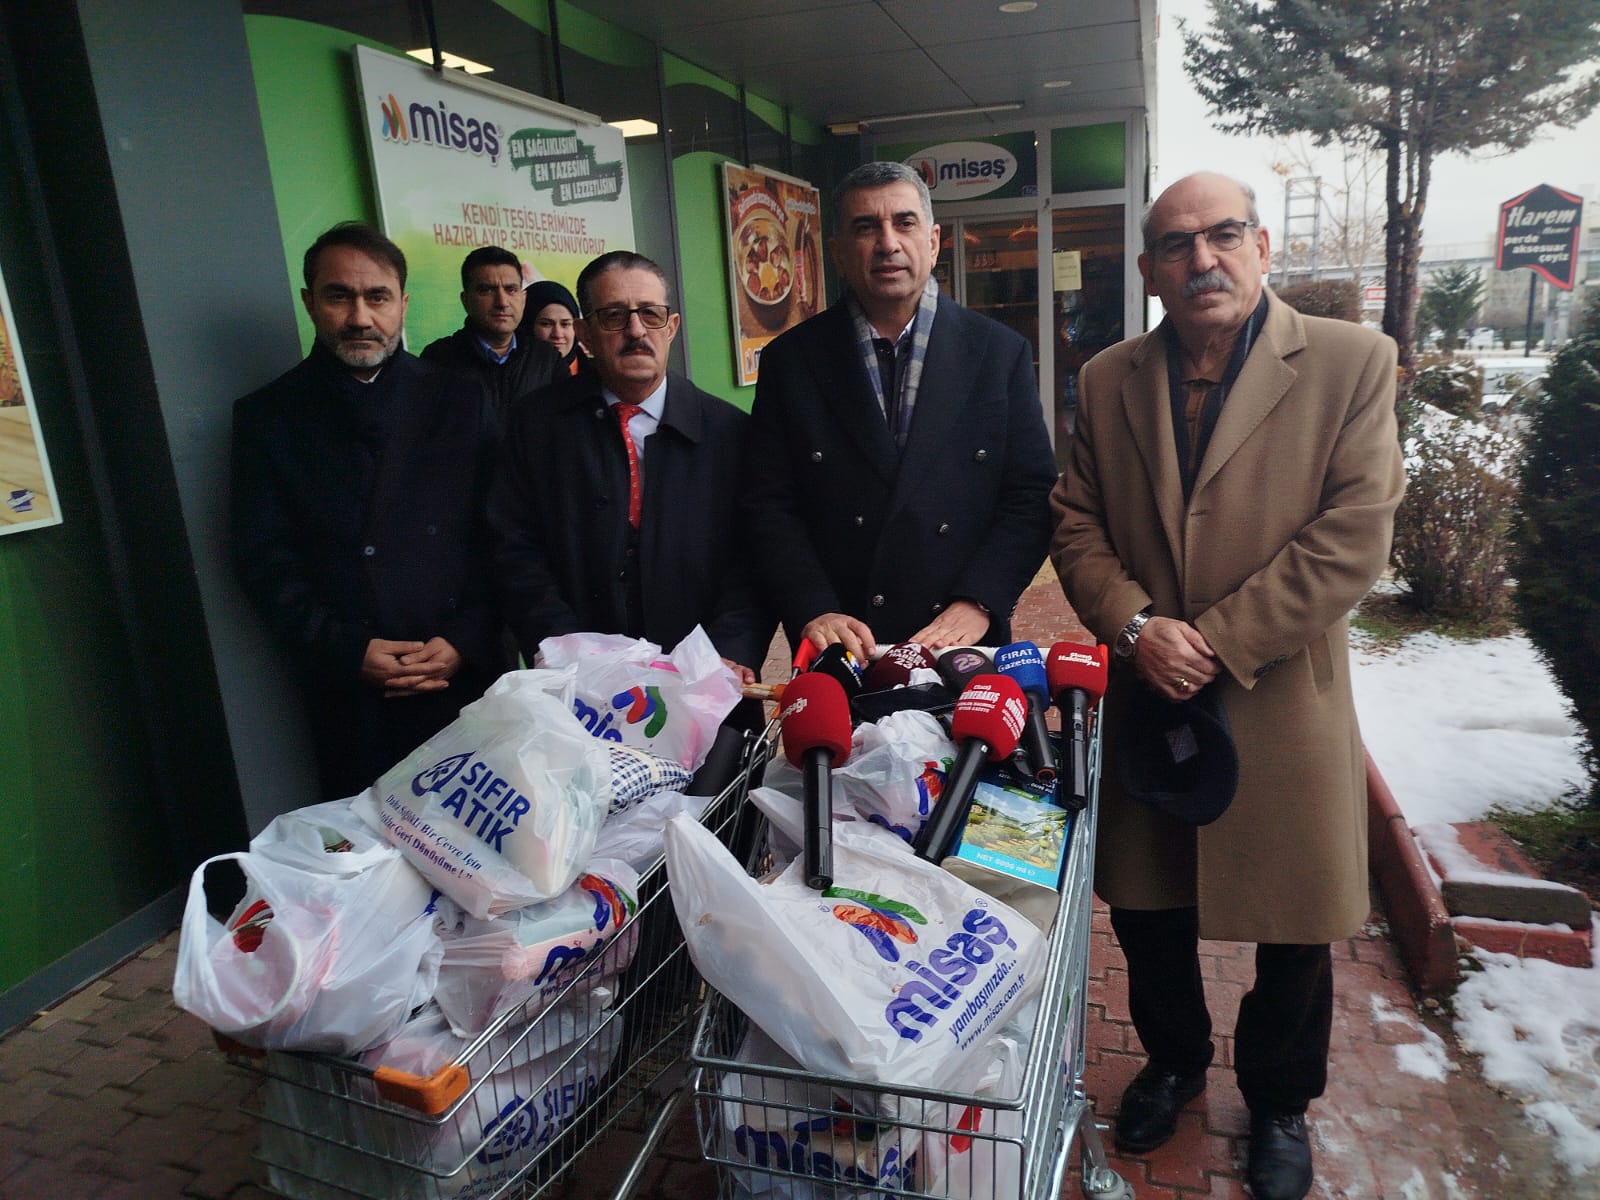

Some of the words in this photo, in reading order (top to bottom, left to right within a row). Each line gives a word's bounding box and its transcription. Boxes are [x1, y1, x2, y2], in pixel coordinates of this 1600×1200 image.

[409, 100, 499, 163] misaş
[512, 139, 525, 158] EN
[535, 163, 548, 182] EN
[941, 158, 1005, 179] misaş
[560, 183, 572, 201] EN
[462, 202, 500, 225] KENDİ
[503, 206, 586, 235] TESİSLERİMİZDE
[1506, 206, 1577, 227] Harem
[433, 224, 507, 249] HAZIRLAYIP
[510, 230, 549, 256] SATIŞA
[551, 235, 606, 255] SUNUYORUZ
[1504, 234, 1539, 246] perde
[1512, 244, 1567, 254] aksesuar
[954, 654, 983, 671] 23
[998, 658, 1040, 673] Gazetesi
[1001, 648, 1034, 662] FIRAT
[460, 761, 531, 826] SIFIR
[441, 787, 514, 854] ATIK
[395, 825, 413, 844] Geri
[420, 824, 436, 838] Bir
[436, 836, 464, 858] Çevre
[885, 908, 1017, 1044] misaş
[949, 960, 1016, 1044] yanıbaşınızda...
